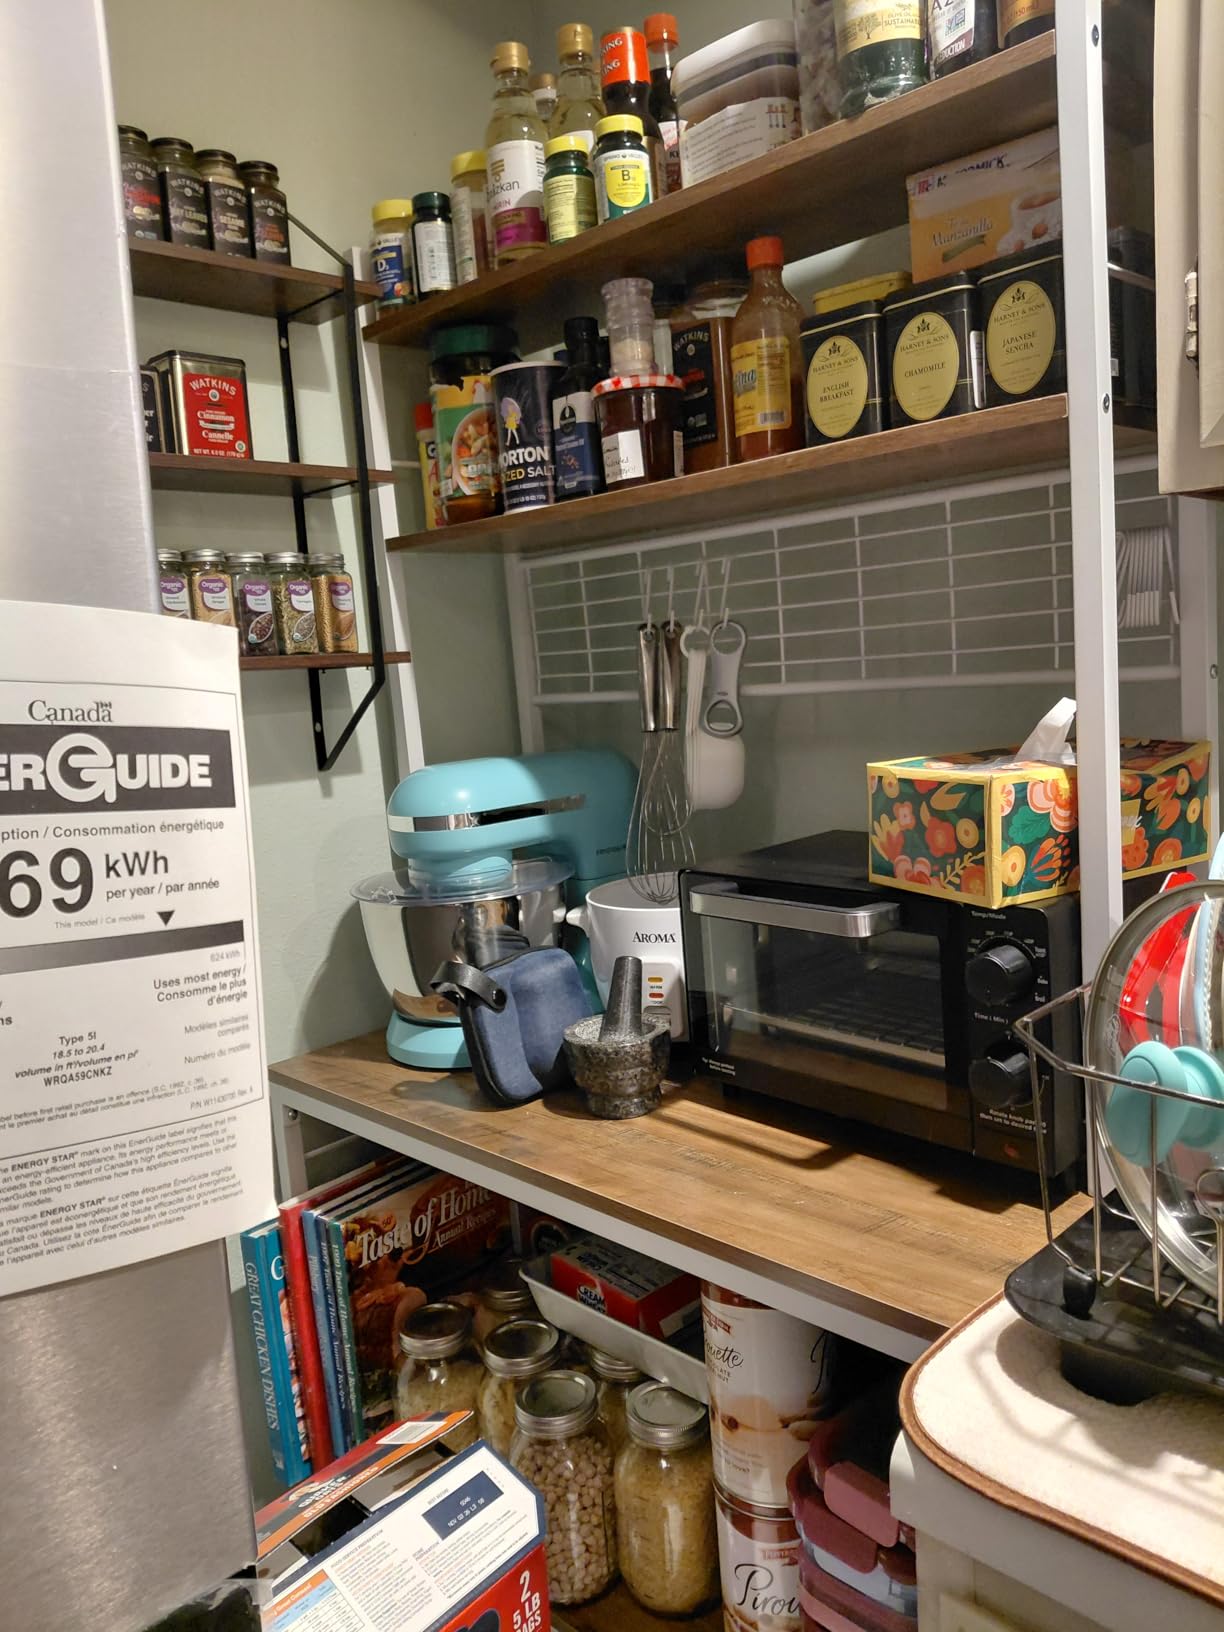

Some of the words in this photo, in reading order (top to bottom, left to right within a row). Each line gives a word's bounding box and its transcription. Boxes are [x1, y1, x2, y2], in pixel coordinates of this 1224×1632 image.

[673, 330, 710, 351] WATKINS
[900, 342, 925, 352] HARNEY
[1002, 331, 1037, 348] JAPANESE
[904, 362, 947, 378] CHAMOMILE
[189, 377, 237, 396] WATKINS
[820, 389, 854, 403] BREAKFAST
[822, 381, 850, 393] ENGLISH
[527, 465, 556, 478] SALT
[28, 700, 113, 724] Canada
[43, 827, 49, 839] /
[52, 822, 156, 838] Consommation
[159, 818, 225, 835] énergétique
[0, 847, 94, 918] 69
[105, 850, 169, 879] kWh
[106, 886, 127, 901] per
[130, 885, 155, 900] year
[166, 882, 184, 896] par
[187, 877, 220, 891] année
[55, 921, 72, 929] This
[74, 918, 99, 928] model
[632, 931, 674, 944] AROMA
[153, 977, 181, 990] Uses
[184, 972, 210, 984] most
[212, 966, 241, 979] energy
[157, 984, 217, 1002] Consomme
[219, 981, 227, 991] le
[229, 977, 247, 991] plus
[207, 990, 248, 1006] d'énergie
[59, 1035, 84, 1046] Type
[52, 1049, 72, 1060] 18.5
[74, 1047, 84, 1056] to
[85, 1043, 105, 1055] 20.4
[184, 1052, 215, 1064] Numéro
[15, 1066, 52, 1079] volume
[55, 1063, 64, 1072] in
[114, 1054, 126, 1062] en
[43, 1065, 112, 1087] WRQA59CNKZ
[11, 1157, 49, 1172] ENERGY
[40, 1203, 77, 1218] ENERGY
[356, 1221, 413, 1269] Taste
[414, 1196, 438, 1247] of
[438, 1184, 491, 1227] Home
[432, 1222, 465, 1249] Annual
[271, 1255, 285, 1280] G
[245, 1262, 260, 1308] GREAT
[252, 1306, 269, 1378] CHICKEN
[262, 1374, 280, 1431] DISHES
[519, 1570, 531, 1604] 2
[512, 1609, 522, 1630] 5
[524, 1591, 541, 1619] LB
